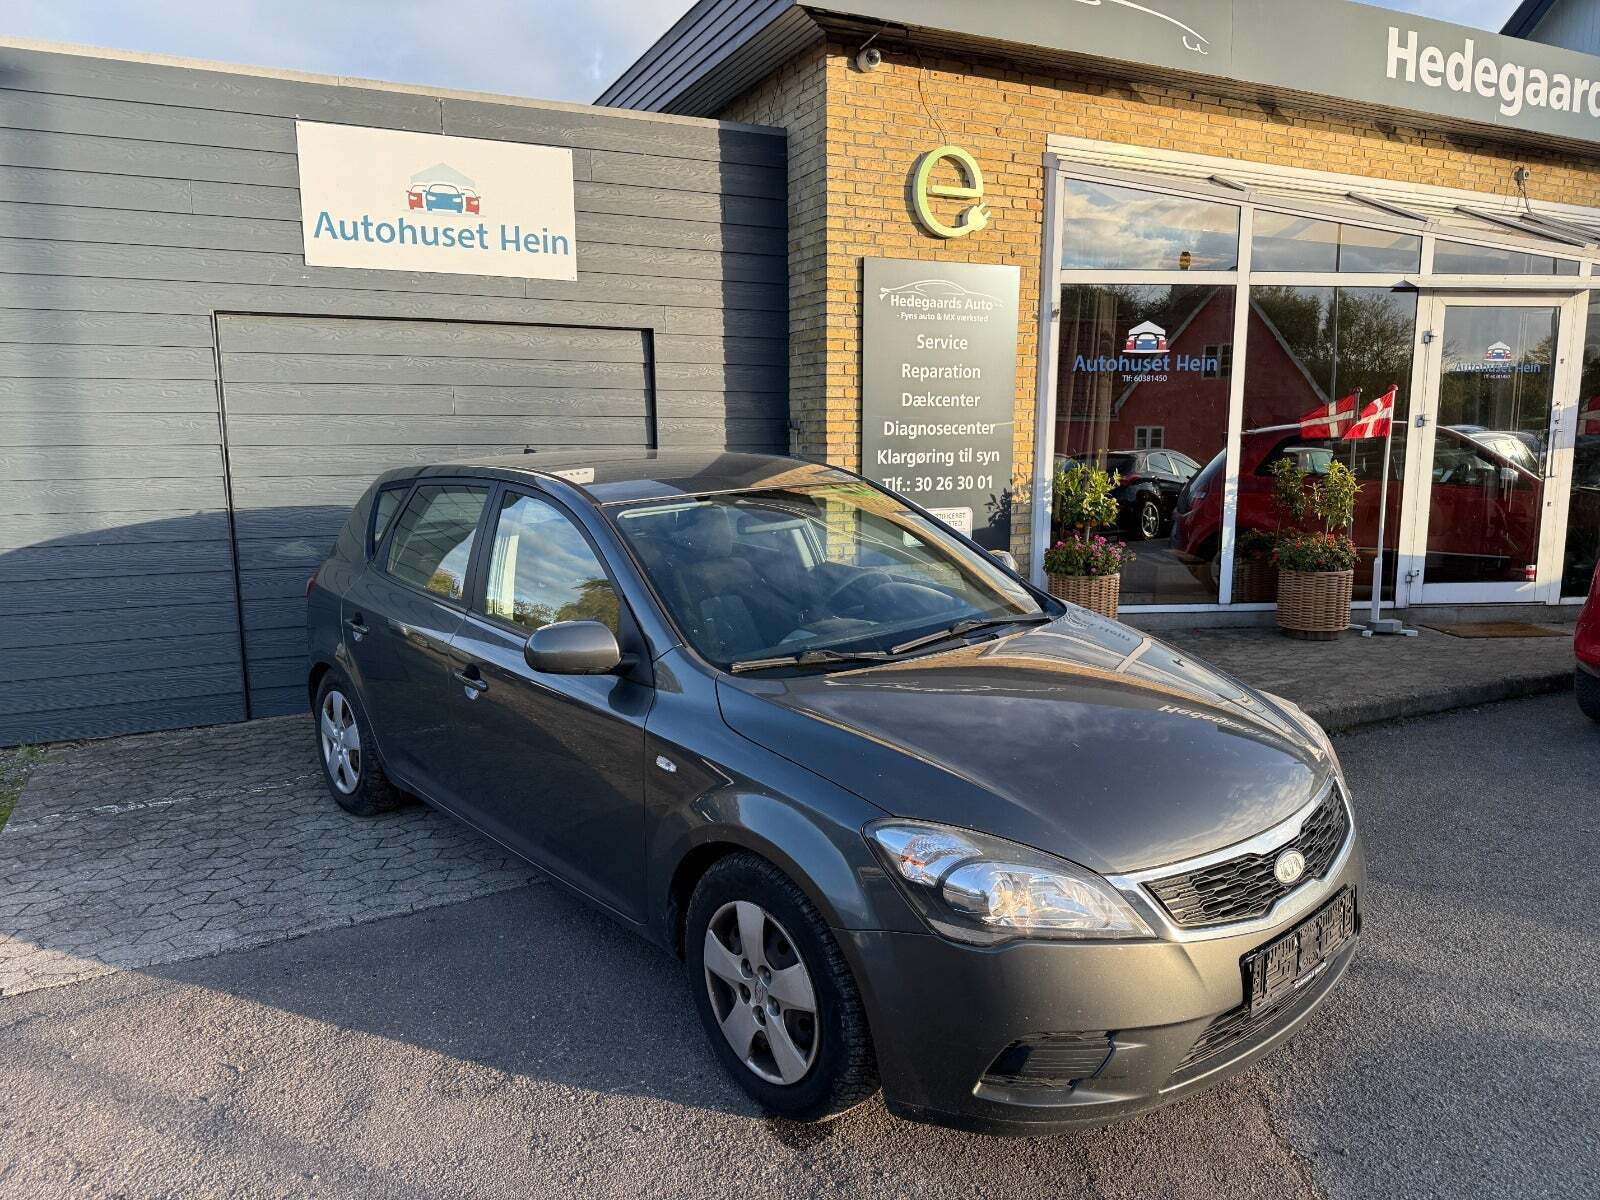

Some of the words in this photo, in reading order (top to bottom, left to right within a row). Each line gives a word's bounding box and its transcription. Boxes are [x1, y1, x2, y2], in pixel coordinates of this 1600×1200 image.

[313, 211, 489, 250] Autohuset
[501, 224, 569, 256] Hein
[890, 295, 962, 311] Hedegaards
[965, 298, 993, 311] Auto
[936, 313, 943, 321] &
[916, 334, 968, 350] Service
[1072, 354, 1170, 372] Autohuset
[1176, 354, 1217, 372] Hein
[1456, 362, 1512, 373] Autohuset
[1516, 362, 1540, 373] Hein
[901, 363, 981, 381] Reparation
[1134, 374, 1168, 382] 60381450
[902, 392, 981, 407] Dækcenter
[884, 421, 995, 439] Diagnosecenter
[877, 449, 954, 467] Klargøring
[958, 448, 972, 463] til
[976, 451, 1000, 466] syn
[915, 477, 932, 492] 30
[936, 477, 953, 491] 26
[957, 476, 974, 490] 30
[977, 475, 993, 489] 01
